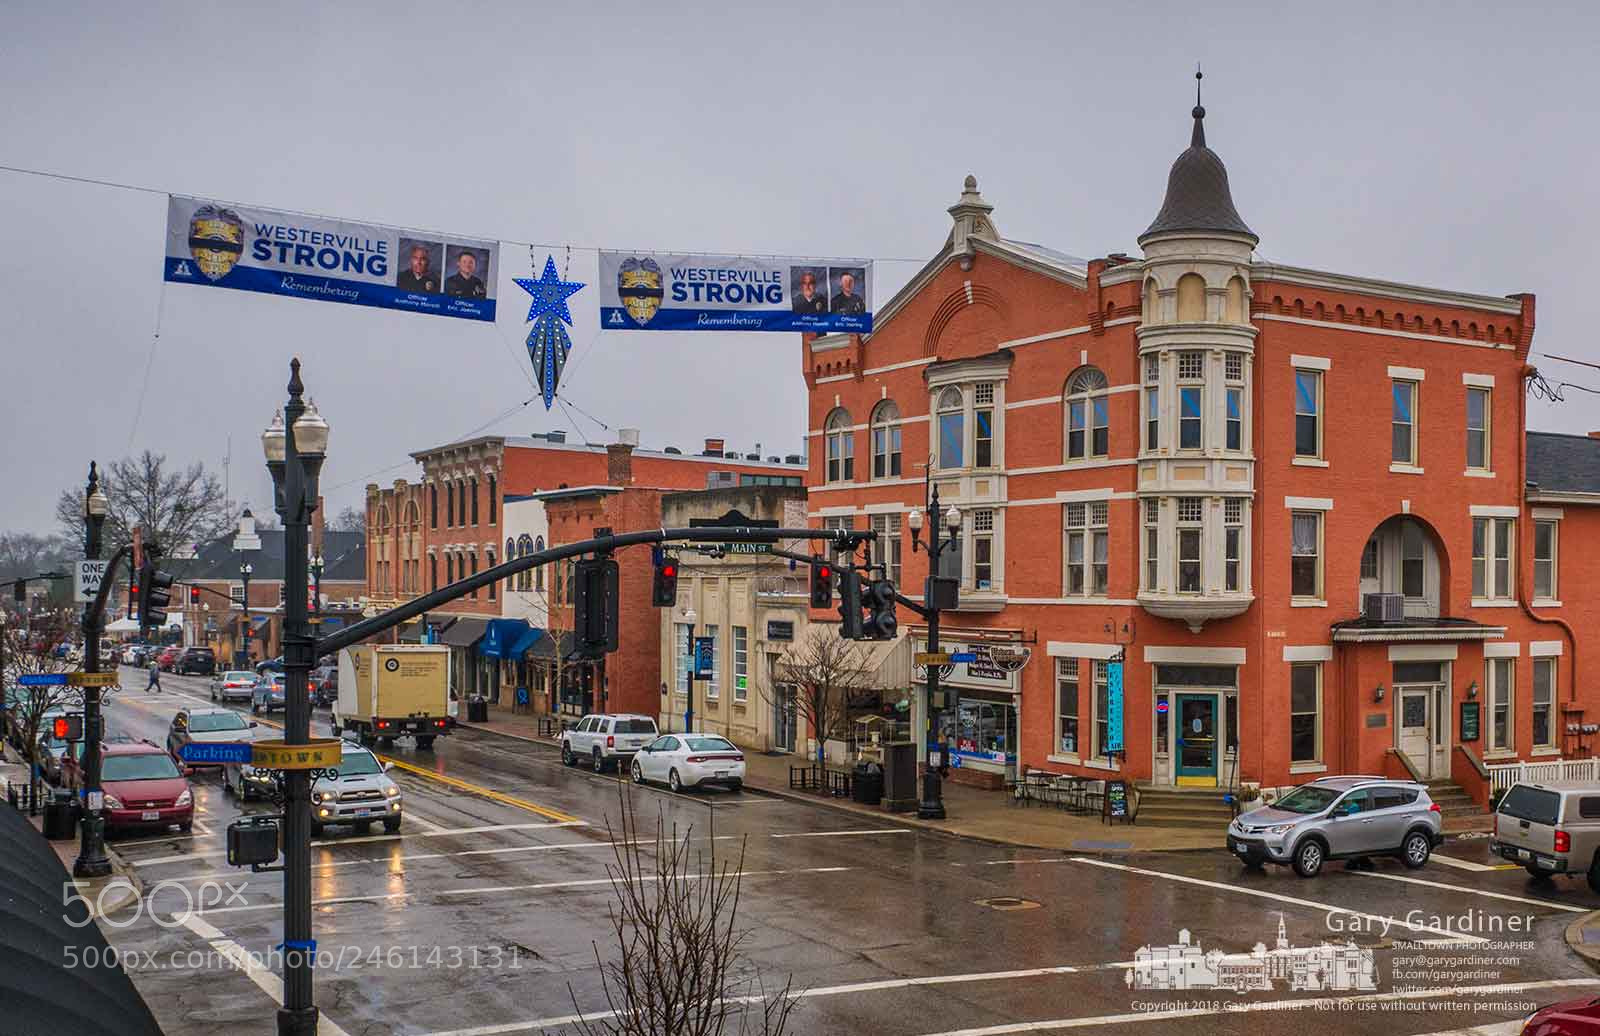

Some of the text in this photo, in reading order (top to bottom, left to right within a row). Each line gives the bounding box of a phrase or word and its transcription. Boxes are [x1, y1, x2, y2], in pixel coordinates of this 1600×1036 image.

[255, 223, 388, 254] WESTERVILLE
[252, 238, 388, 277] STRONG
[670, 267, 782, 284] WESTERVILLE
[280, 274, 360, 299] Remembering
[671, 281, 784, 305] STRONG
[697, 312, 764, 328] Remembering
[731, 543, 757, 553] MAIN
[81, 563, 105, 574] ONE
[182, 744, 245, 762] Parking
